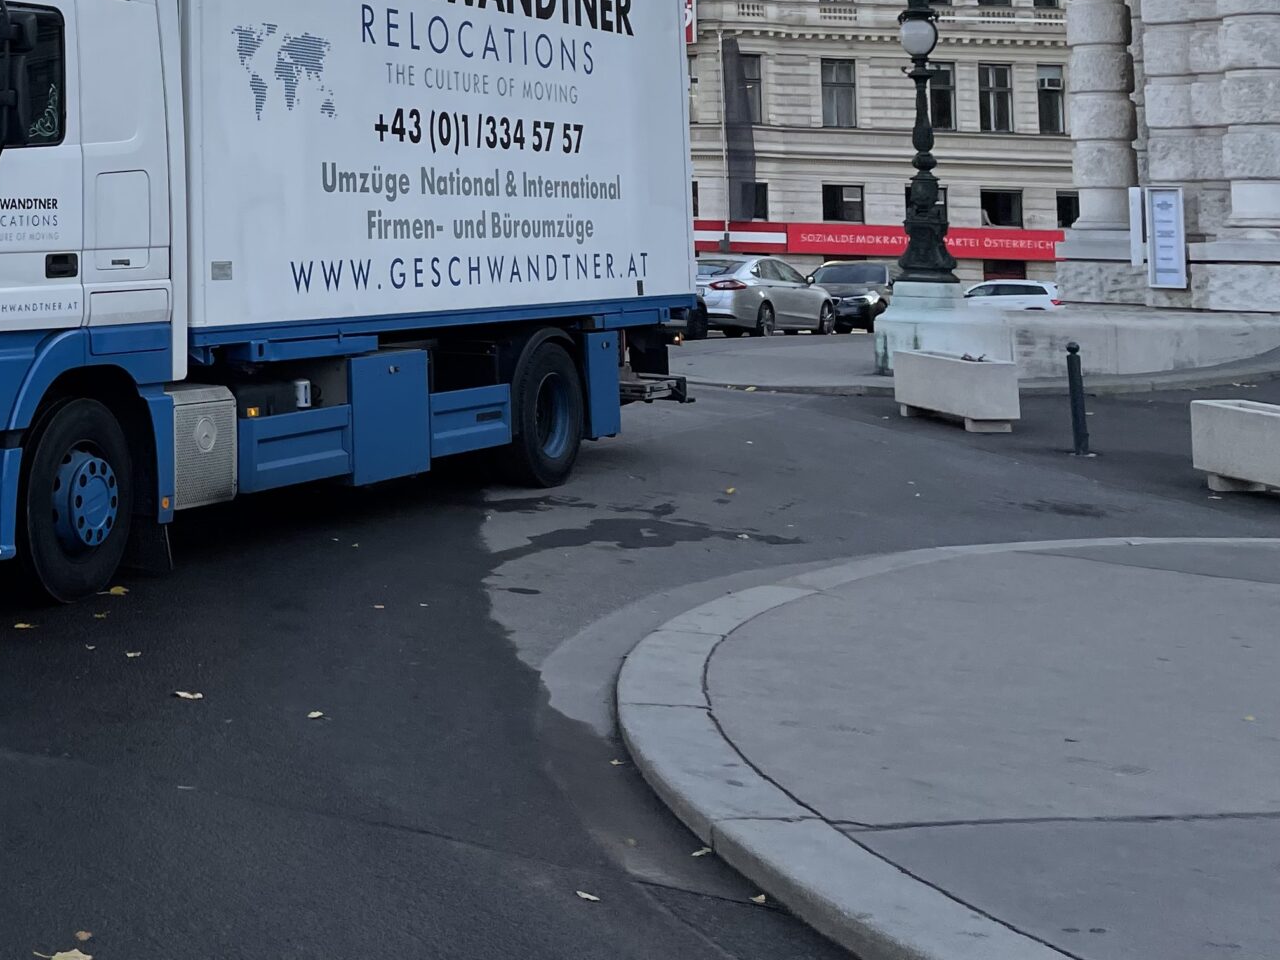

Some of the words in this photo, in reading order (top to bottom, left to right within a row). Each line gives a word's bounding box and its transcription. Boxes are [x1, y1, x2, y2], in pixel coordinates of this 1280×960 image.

[361, 3, 594, 75] RELOCATIONS
[385, 62, 416, 86] THE
[424, 67, 489, 96] CULTURE
[496, 76, 516, 98] OF
[522, 81, 579, 105] MOVING
[374, 107, 422, 144] +43
[532, 120, 555, 152] 57
[562, 123, 584, 154] 57
[321, 161, 410, 202] Umzüge
[420, 166, 500, 198] National
[505, 173, 518, 198] &
[522, 172, 621, 200] International
[16, 232, 27, 241] OF
[29, 231, 60, 241] MOVING
[367, 210, 444, 240] Firmen-
[453, 210, 487, 239] und
[491, 212, 594, 245] Büroumzüge
[800, 233, 910, 244] SOZIALDEMOKRATI
[983, 237, 1054, 249] ÖSTERREICH
[290, 252, 649, 294] WWW.GESCHWANDTNER.AT
